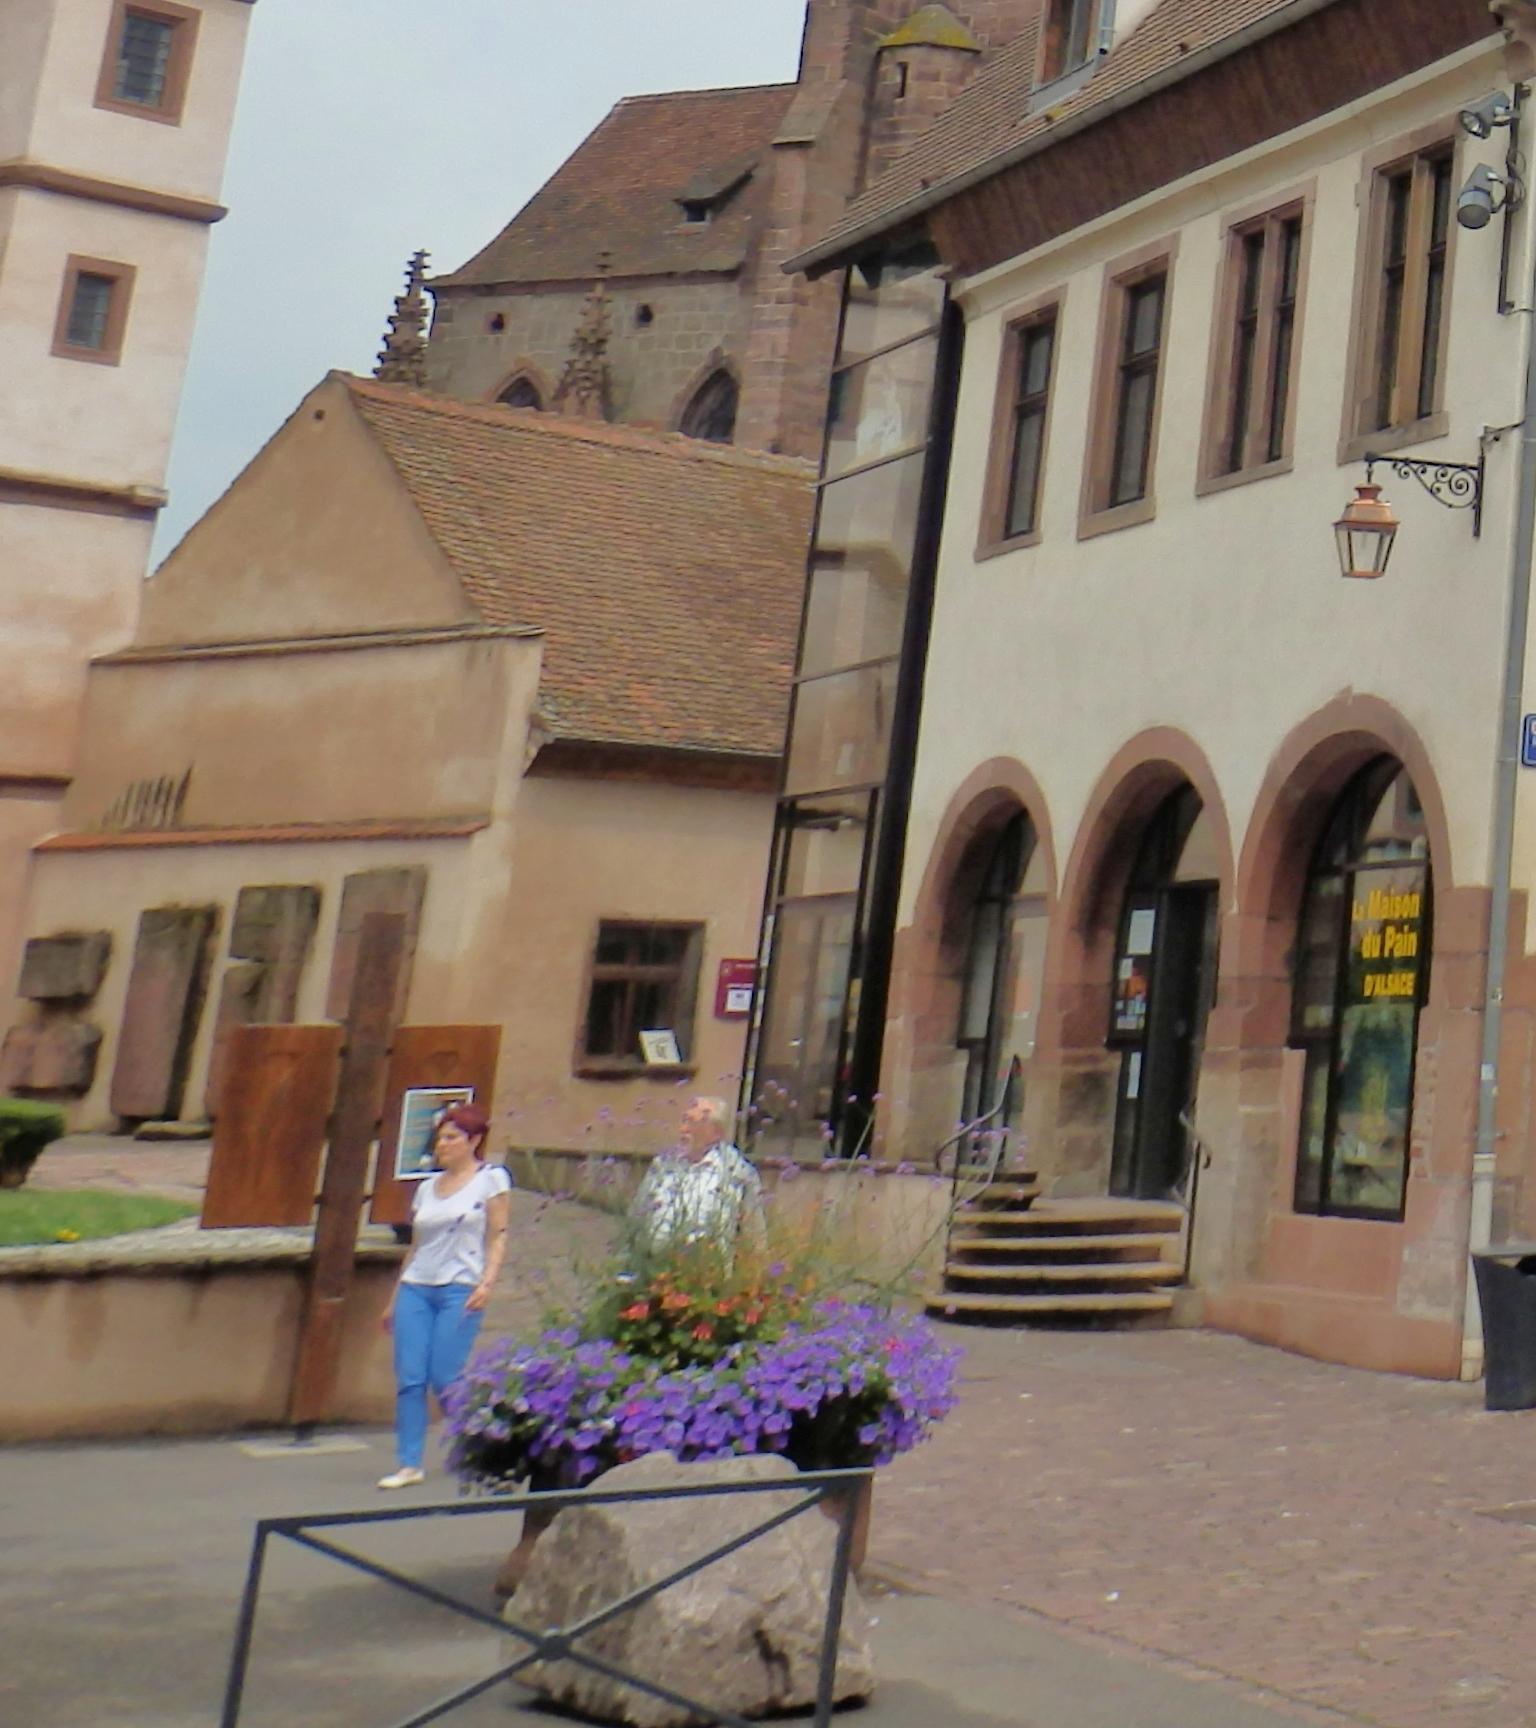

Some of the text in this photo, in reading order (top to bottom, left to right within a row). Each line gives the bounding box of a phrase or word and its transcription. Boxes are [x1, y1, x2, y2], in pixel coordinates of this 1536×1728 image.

[1368, 888, 1420, 920] Maison
[1361, 925, 1418, 959] du Pain
[1363, 972, 1415, 997] D'ALSACE
